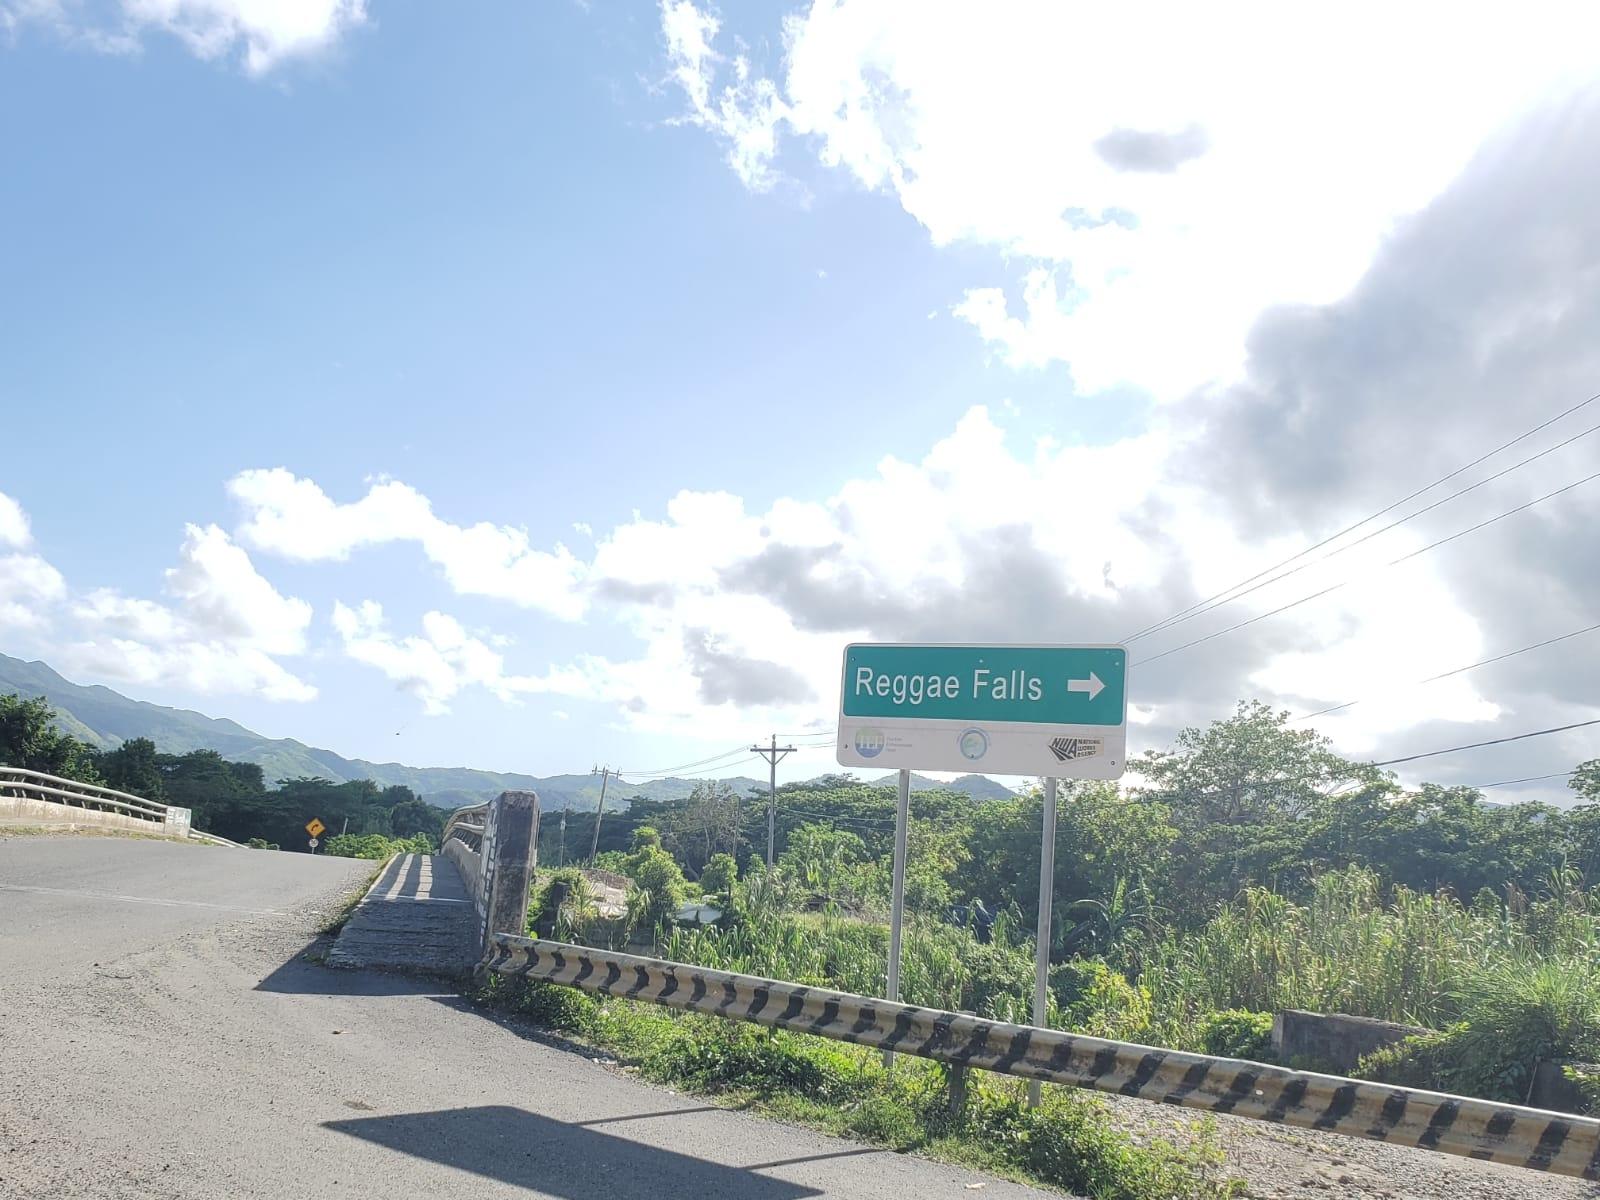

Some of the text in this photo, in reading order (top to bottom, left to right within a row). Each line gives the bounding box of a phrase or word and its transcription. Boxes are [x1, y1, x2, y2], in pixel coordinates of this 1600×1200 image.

[855, 667, 1043, 705] Reggae Falls
[1052, 738, 1077, 757] NWA
